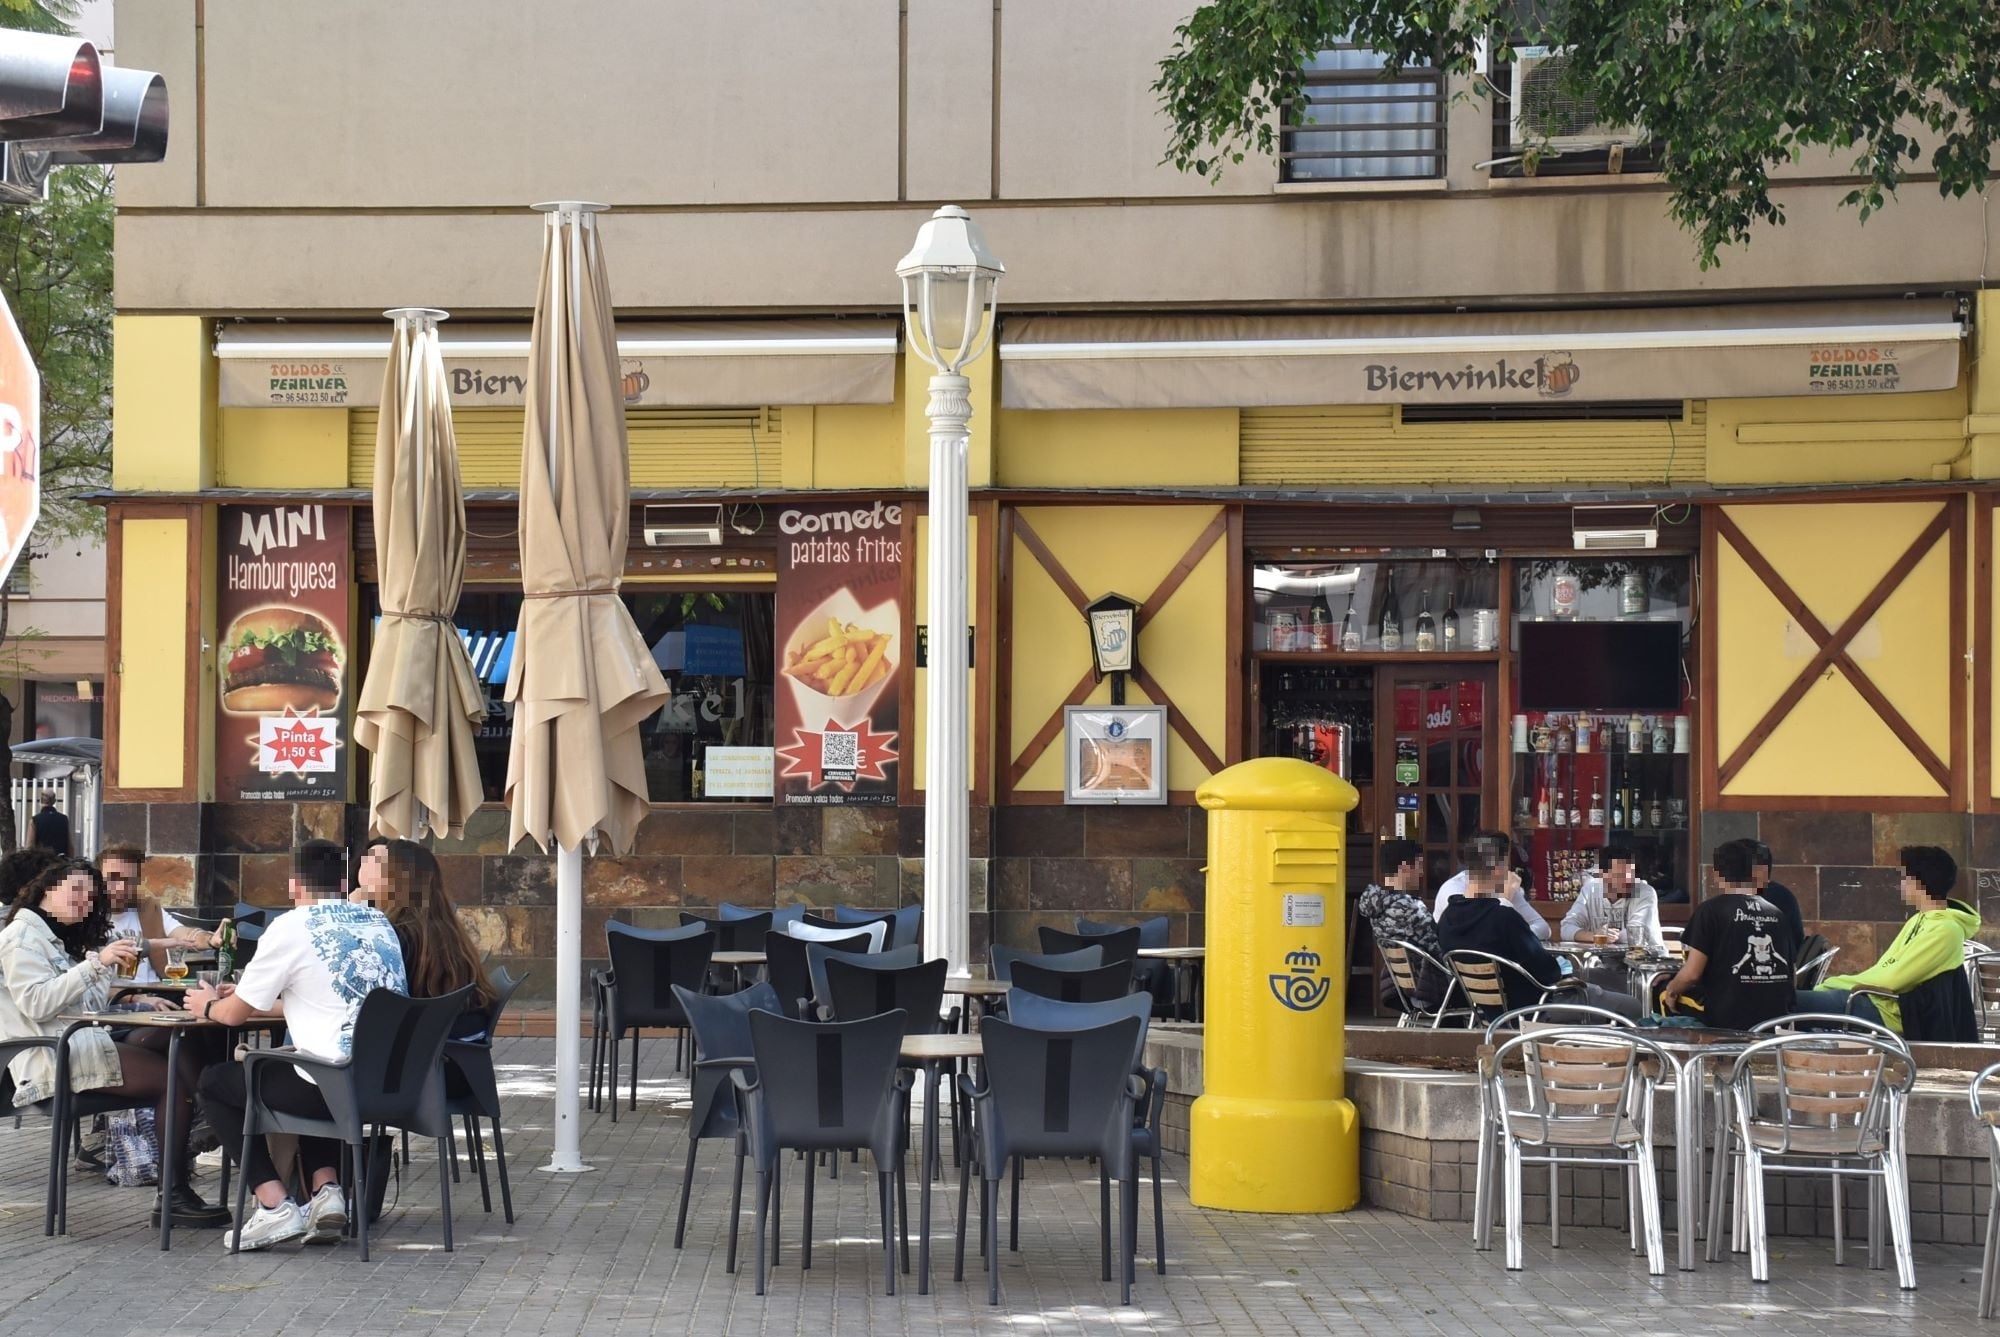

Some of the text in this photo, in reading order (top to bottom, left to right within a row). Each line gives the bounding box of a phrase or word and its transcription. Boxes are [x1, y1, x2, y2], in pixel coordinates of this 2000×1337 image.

[1810, 348, 1879, 362] TOLDOS
[270, 363, 331, 376] TOLDOS
[1363, 358, 1544, 391] Bierwinkel
[1827, 380, 1837, 390] 96
[1839, 380, 1854, 390] 543
[1856, 379, 1865, 390] 23
[1867, 378, 1877, 389] 50
[285, 392, 295, 402] 96
[296, 392, 309, 402] 543
[310, 392, 319, 402] 23
[320, 392, 329, 402] 50
[778, 500, 902, 535] Cornete
[239, 504, 326, 556] MINI
[791, 536, 850, 570] patatas
[229, 554, 337, 598] Hamburguesa
[281, 731, 316, 743] Pinta
[281, 747, 317, 758] 1,50 €
